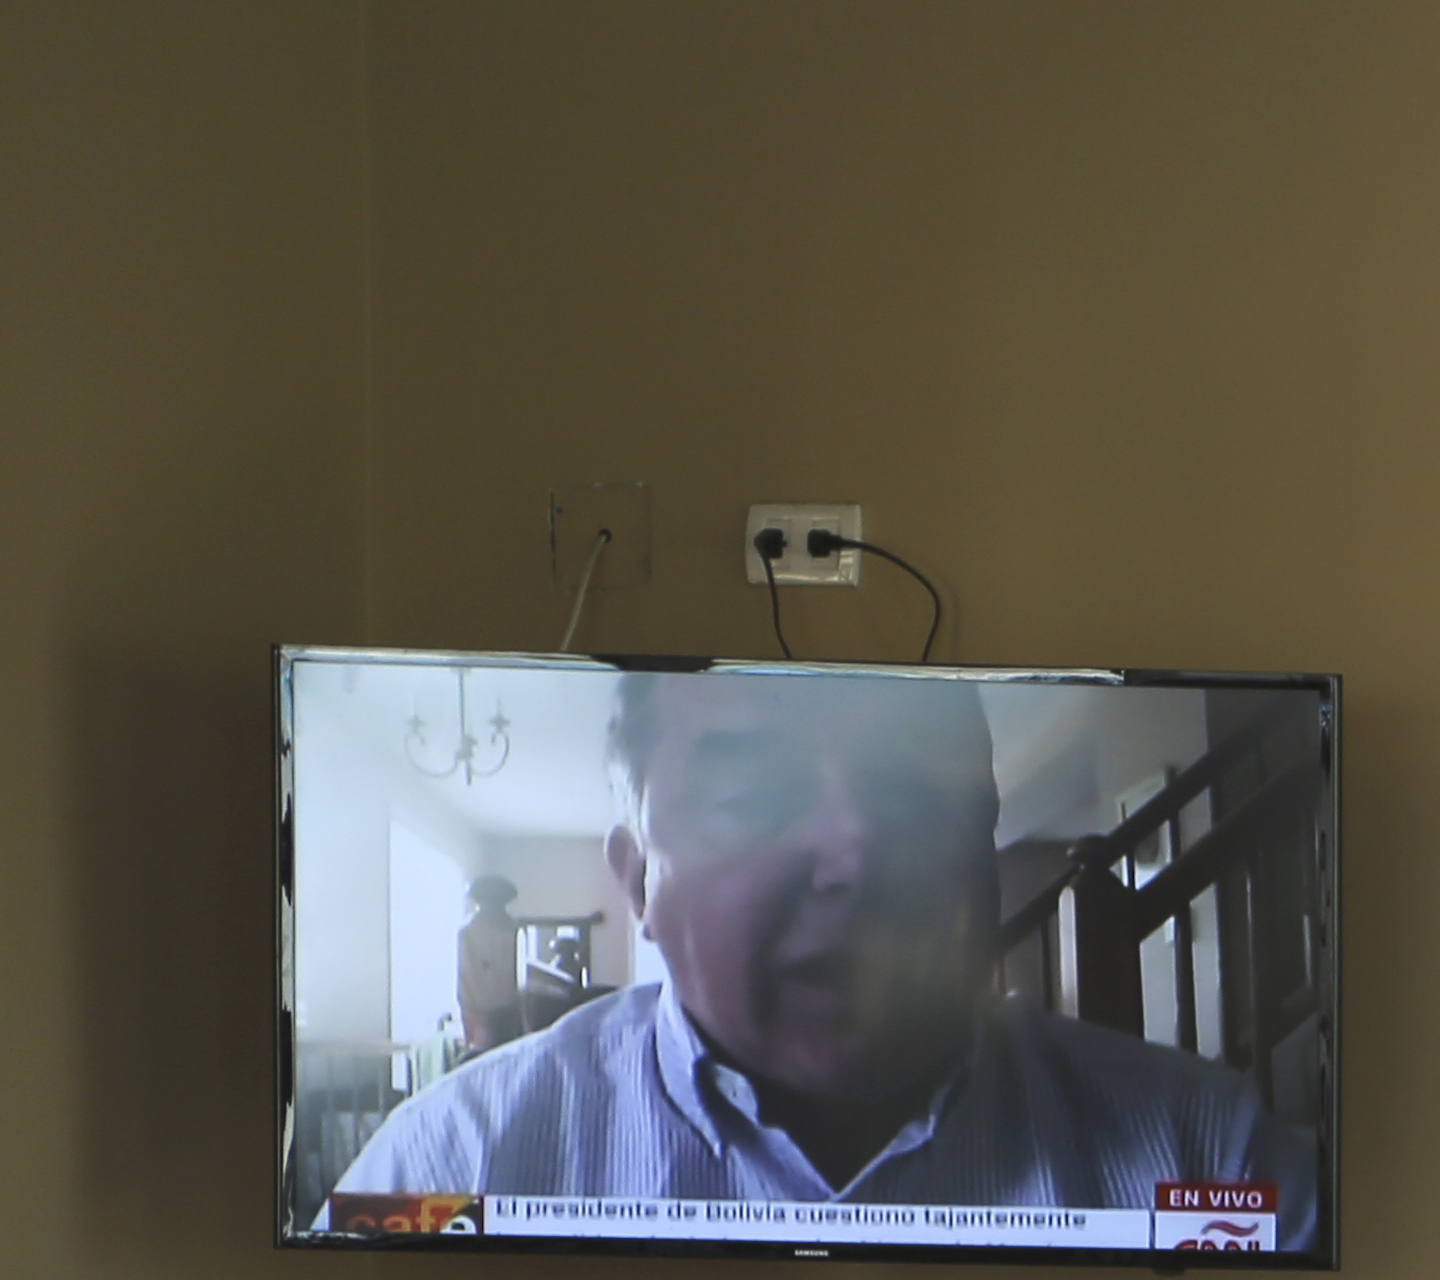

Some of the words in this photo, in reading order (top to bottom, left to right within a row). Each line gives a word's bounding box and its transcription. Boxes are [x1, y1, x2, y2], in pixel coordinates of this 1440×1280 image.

[1168, 1189, 1199, 1207] EN
[1208, 1190, 1263, 1209] VIVO
[496, 1199, 517, 1217] El
[526, 1200, 659, 1222] presidente
[667, 1201, 697, 1220] de
[705, 1201, 786, 1222] Bolivia
[924, 1207, 1086, 1230] tajantemente
